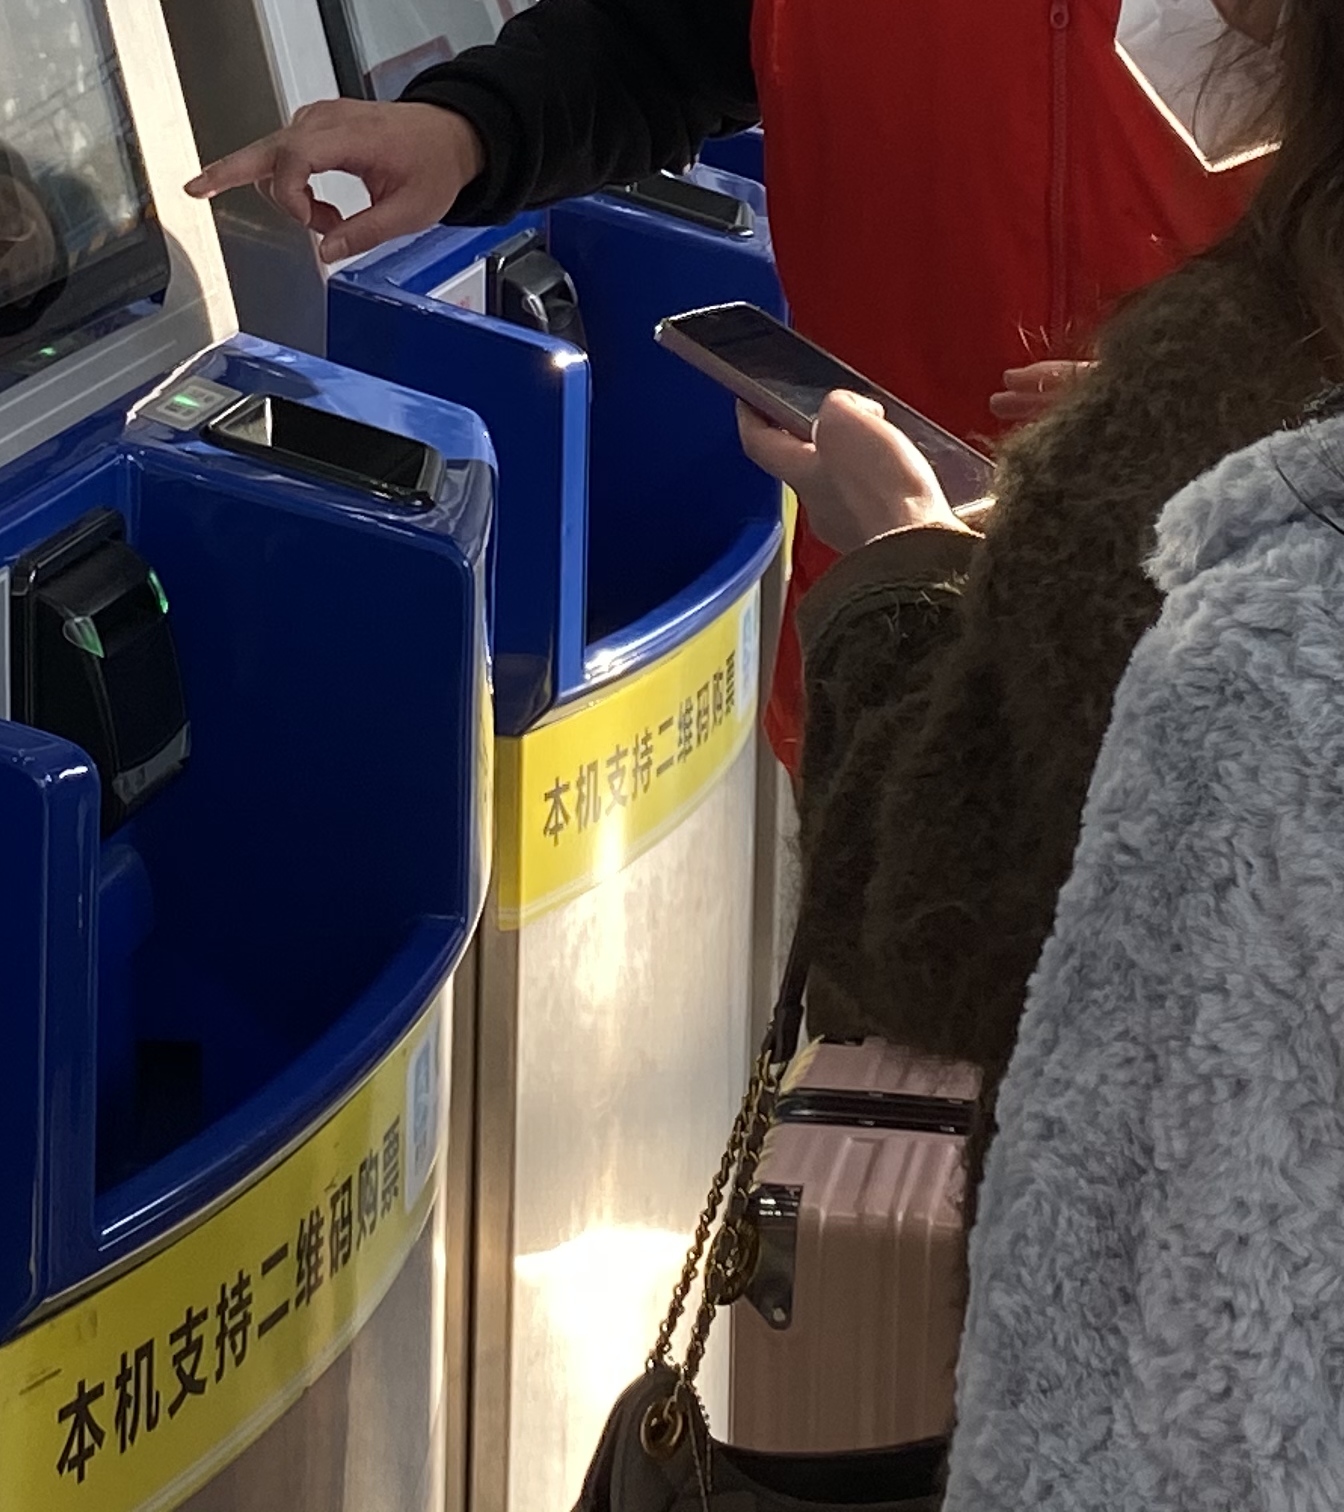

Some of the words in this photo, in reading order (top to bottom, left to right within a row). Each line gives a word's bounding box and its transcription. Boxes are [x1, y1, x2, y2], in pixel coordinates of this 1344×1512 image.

[543, 649, 735, 848] 本机支持二维码购票
[56, 1115, 400, 1484] 本机支持二维码购票
